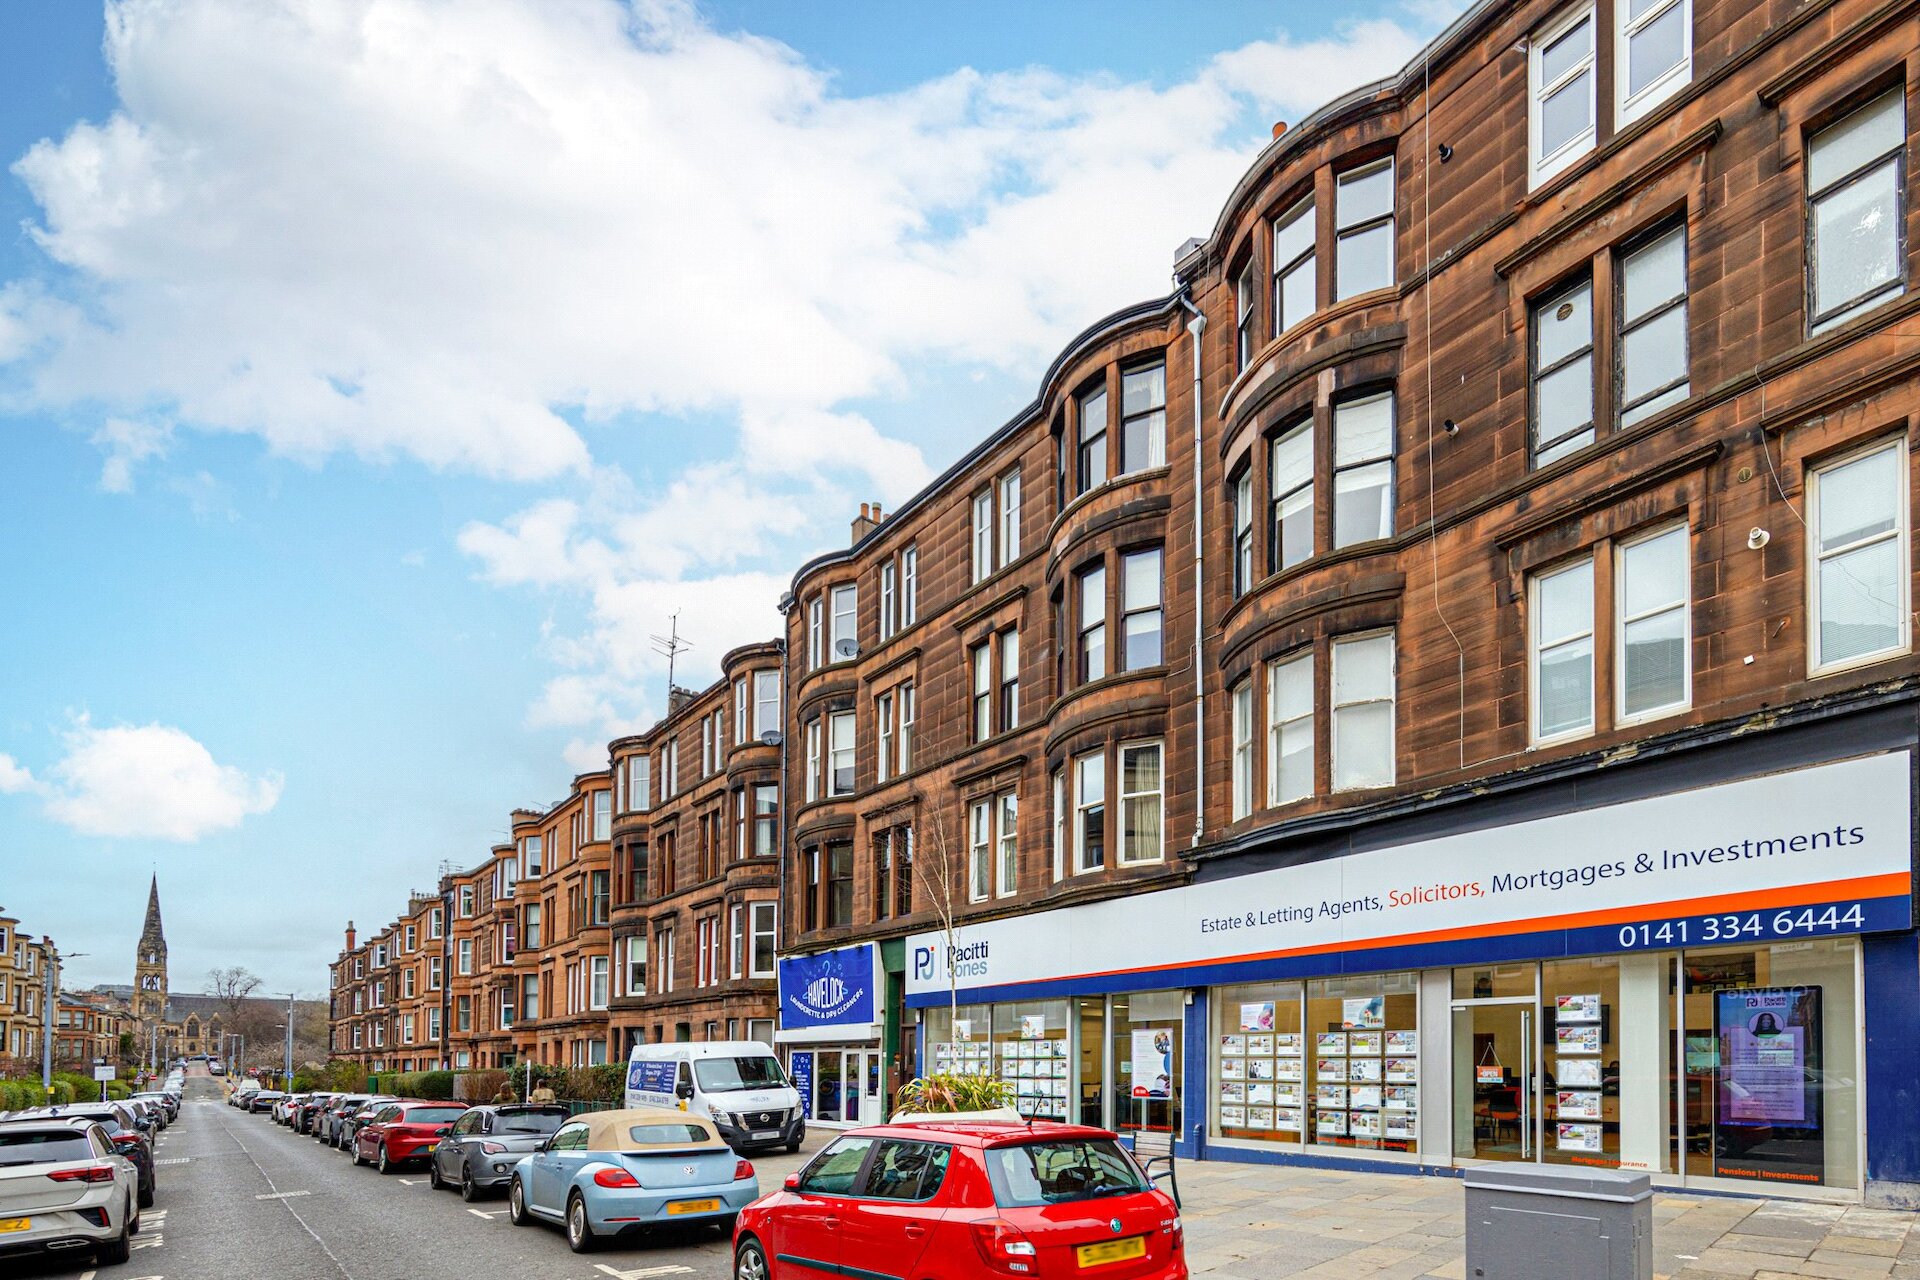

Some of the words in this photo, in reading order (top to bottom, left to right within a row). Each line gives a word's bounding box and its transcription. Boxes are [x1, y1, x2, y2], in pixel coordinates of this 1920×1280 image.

[1200, 911, 1242, 933] Estate
[1245, 912, 1256, 927] &
[1260, 905, 1313, 923] Letting
[1319, 895, 1384, 920] Agents,
[1389, 881, 1486, 908] Solicitors,
[1491, 858, 1626, 893] Mortgages
[1634, 853, 1654, 874] &
[1663, 825, 1865, 870] Investments
[1619, 920, 1689, 948] 0141
[1702, 913, 1763, 941] 334
[1772, 904, 1865, 935] 6444
[947, 941, 989, 969] Pacitti
[808, 977, 844, 1009] HAVELOCK
[1718, 1166, 1757, 1177] Pensions
[1762, 1170, 1819, 1182] Investments
